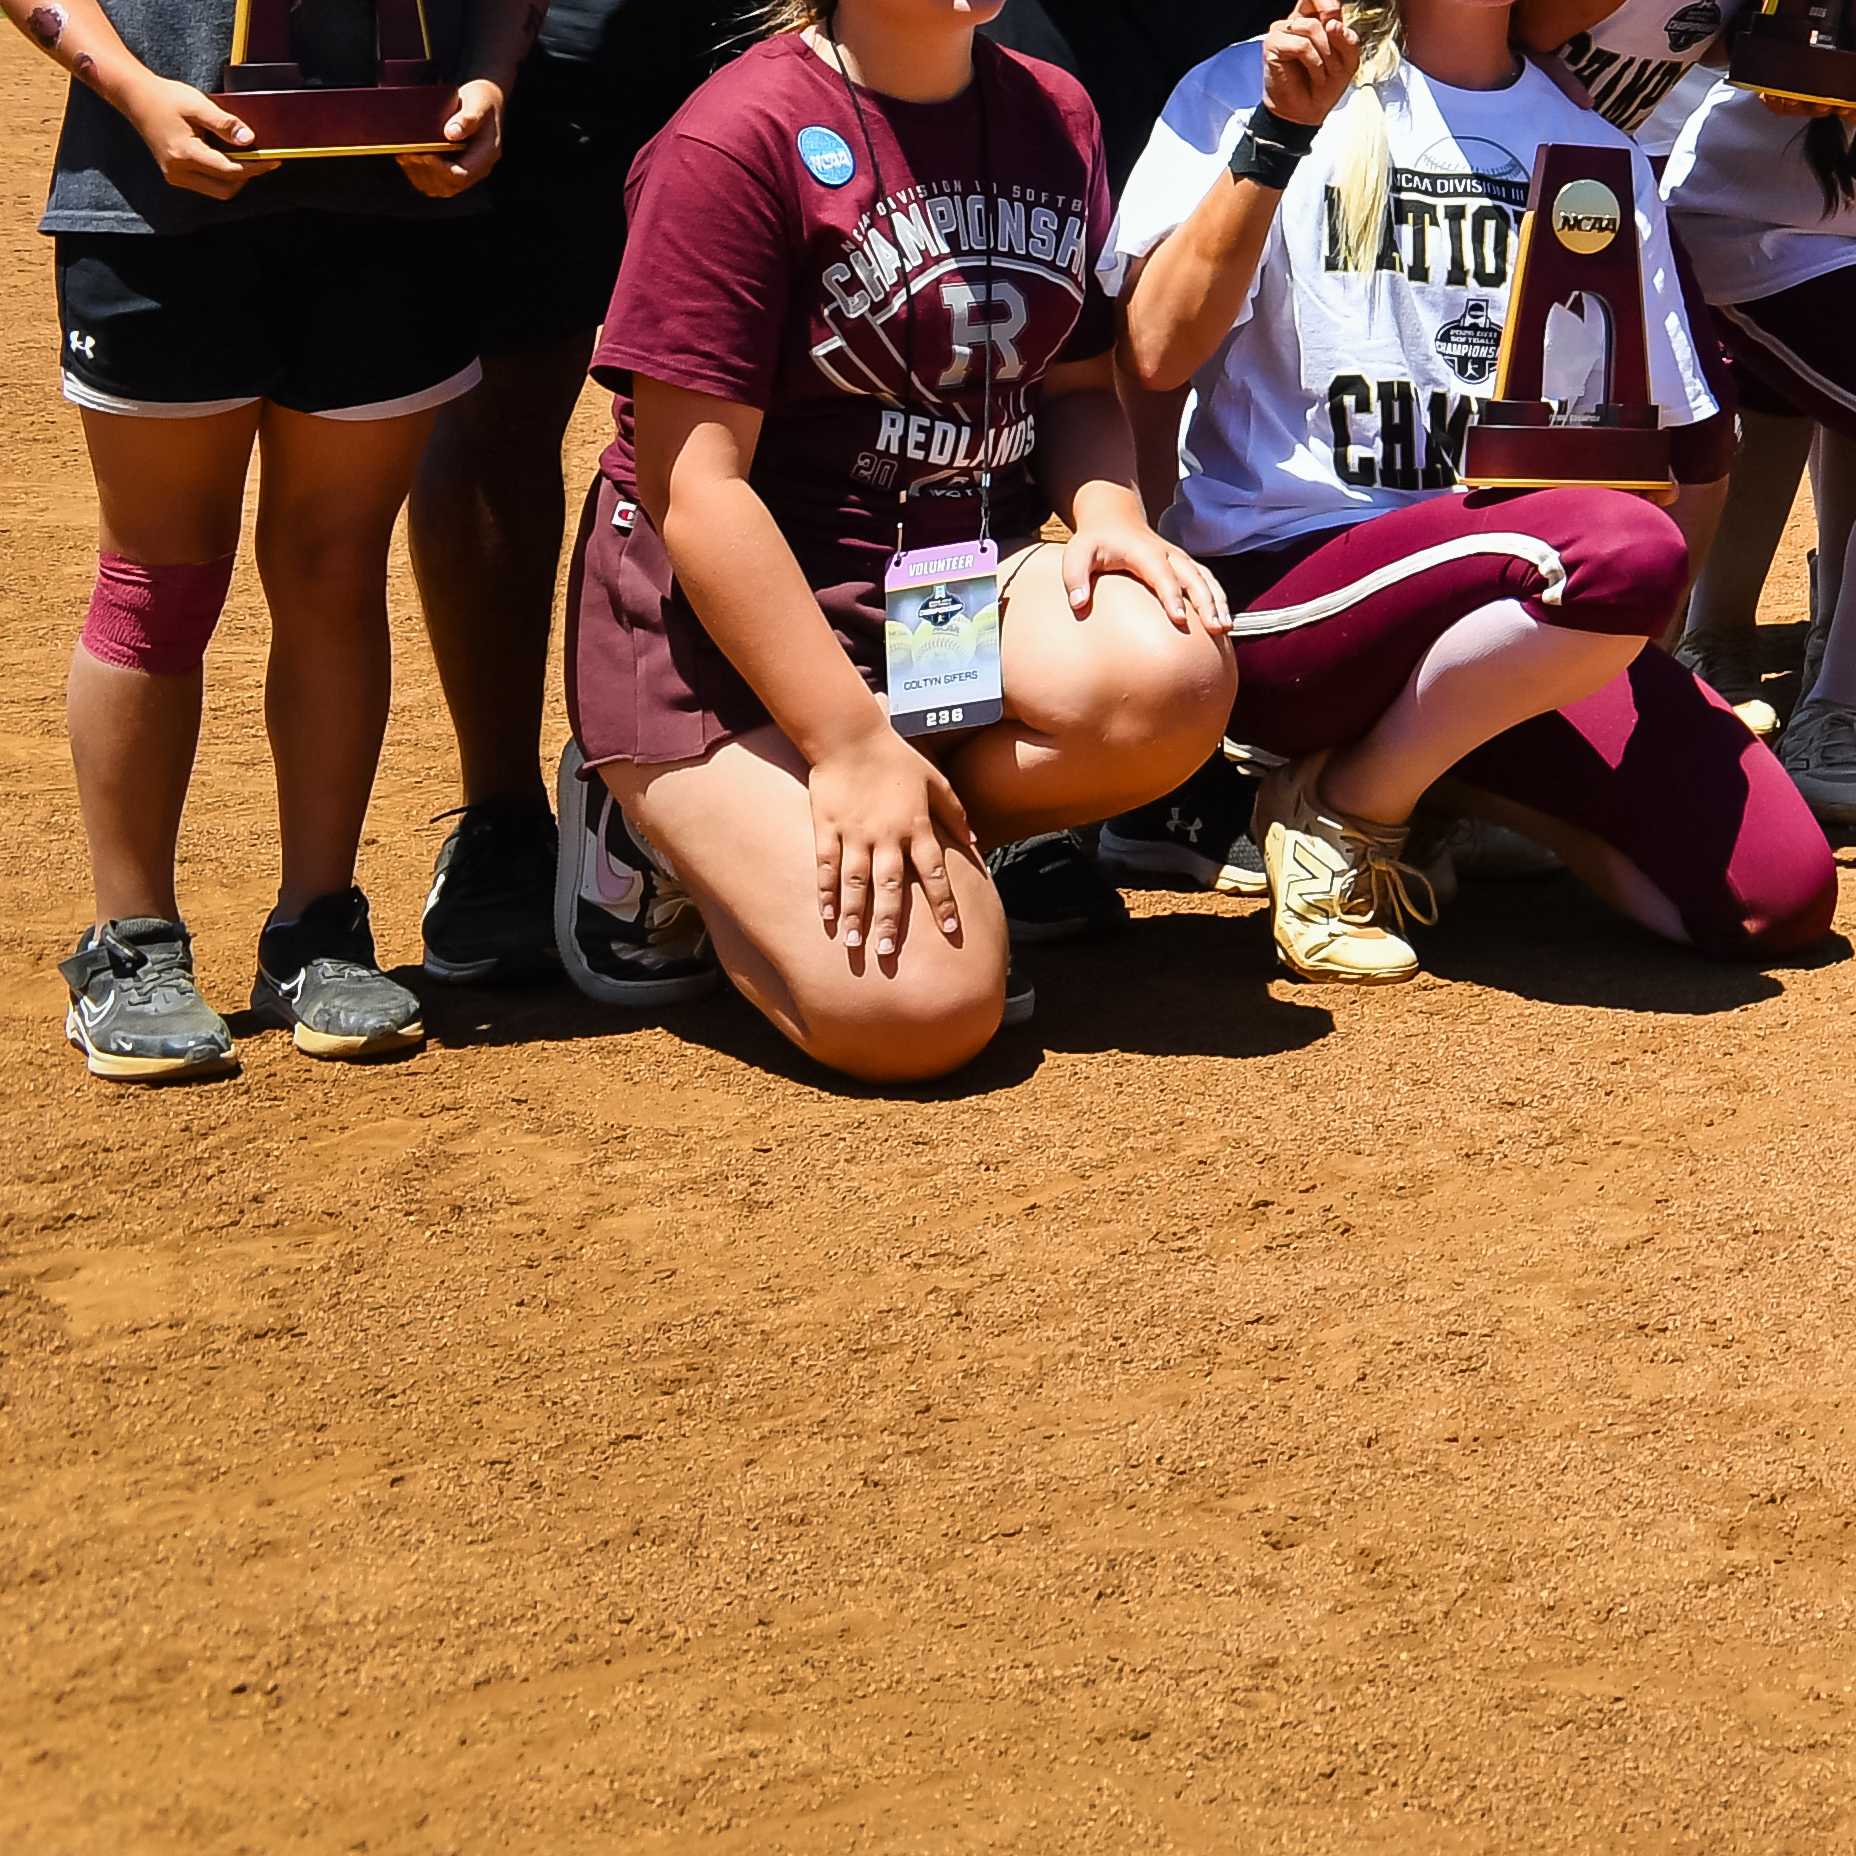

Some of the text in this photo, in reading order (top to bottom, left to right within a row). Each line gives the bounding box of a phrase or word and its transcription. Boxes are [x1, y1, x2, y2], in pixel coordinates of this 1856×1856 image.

[808, 151, 851, 170] NCAA
[876, 179, 963, 217] DIVISION
[1436, 178, 1506, 200] DIVISION
[1556, 213, 1617, 235] NCAA
[938, 280, 1029, 390] R
[876, 410, 1035, 468] REDLANDS
[908, 554, 974, 577] VOLUNTEER
